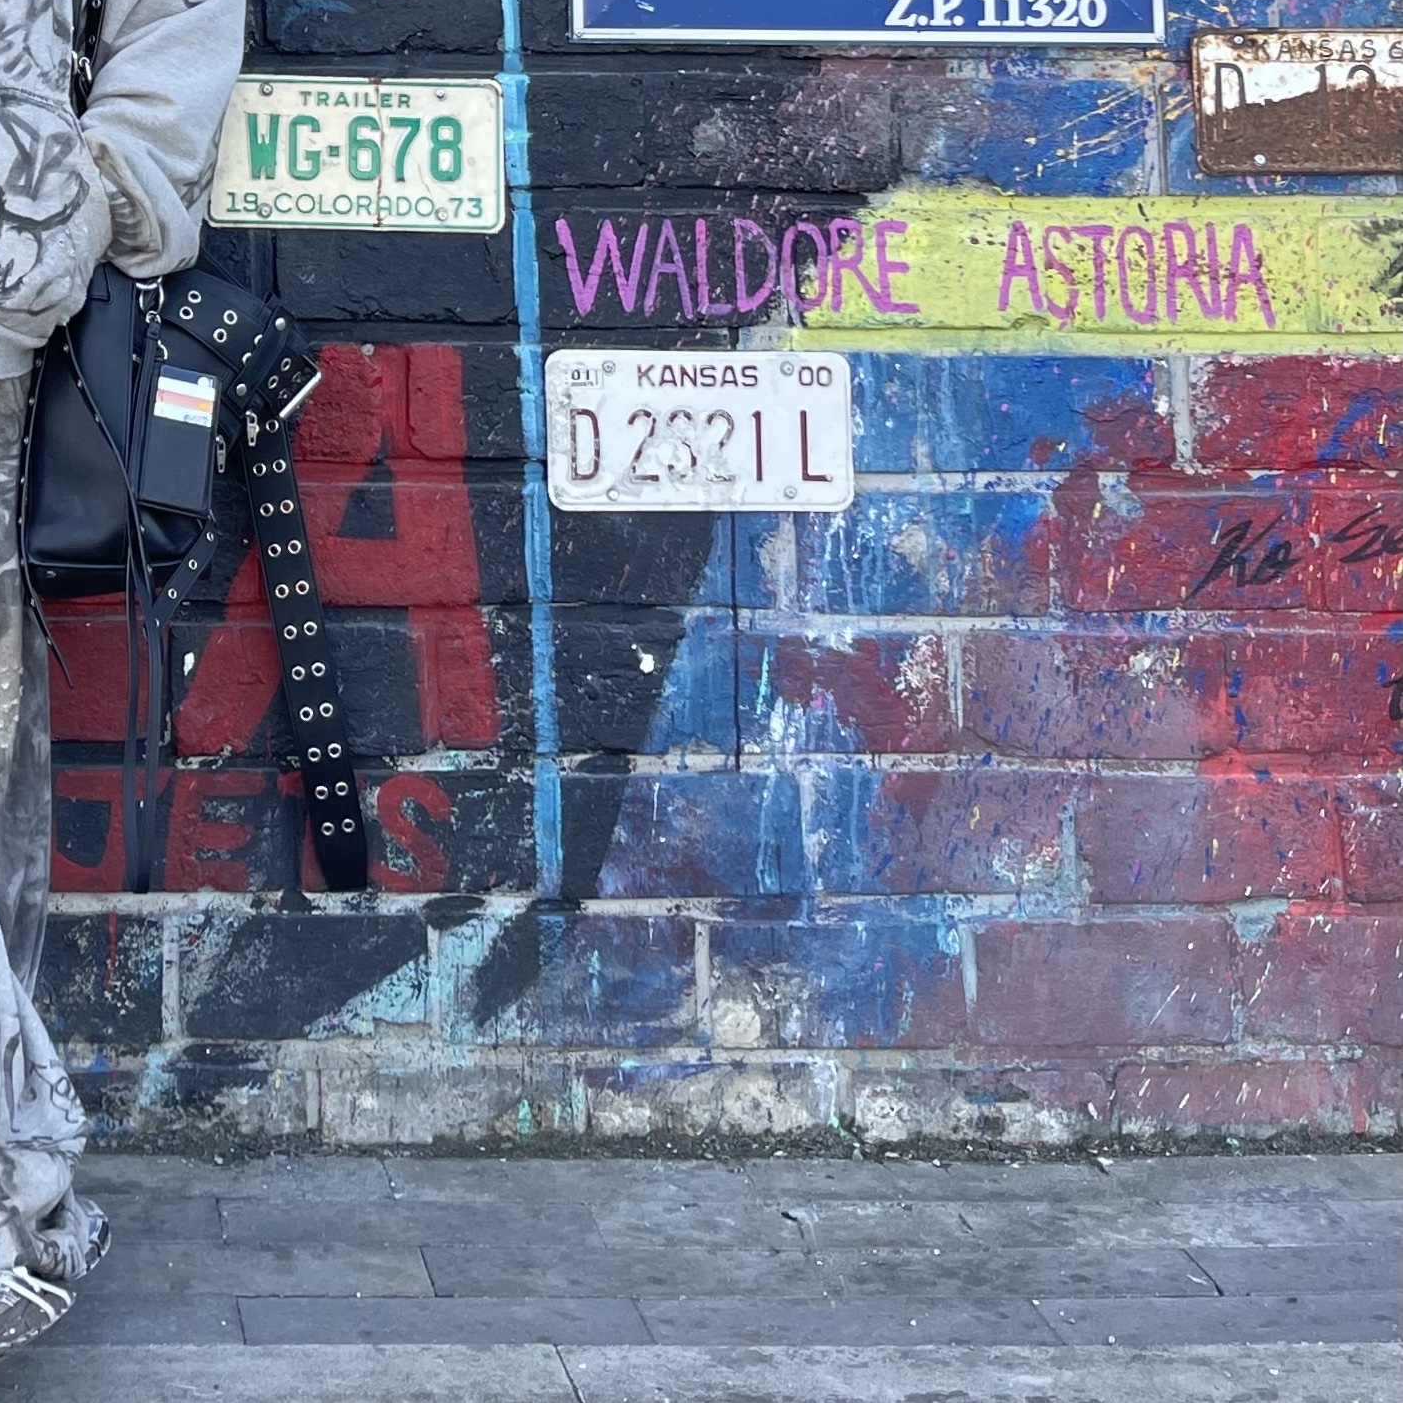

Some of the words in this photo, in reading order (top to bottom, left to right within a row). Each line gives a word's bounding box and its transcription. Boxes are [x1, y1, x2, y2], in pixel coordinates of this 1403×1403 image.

[1254, 39, 1377, 61] KANSAS
[299, 91, 412, 108] TRAILER
[226, 192, 259, 212] 19
[274, 193, 435, 217] COLORADO
[450, 198, 483, 218] 73
[555, 217, 920, 318] WALDORE
[998, 218, 1276, 328] ASTORIA
[636, 364, 759, 387] KANSAS
